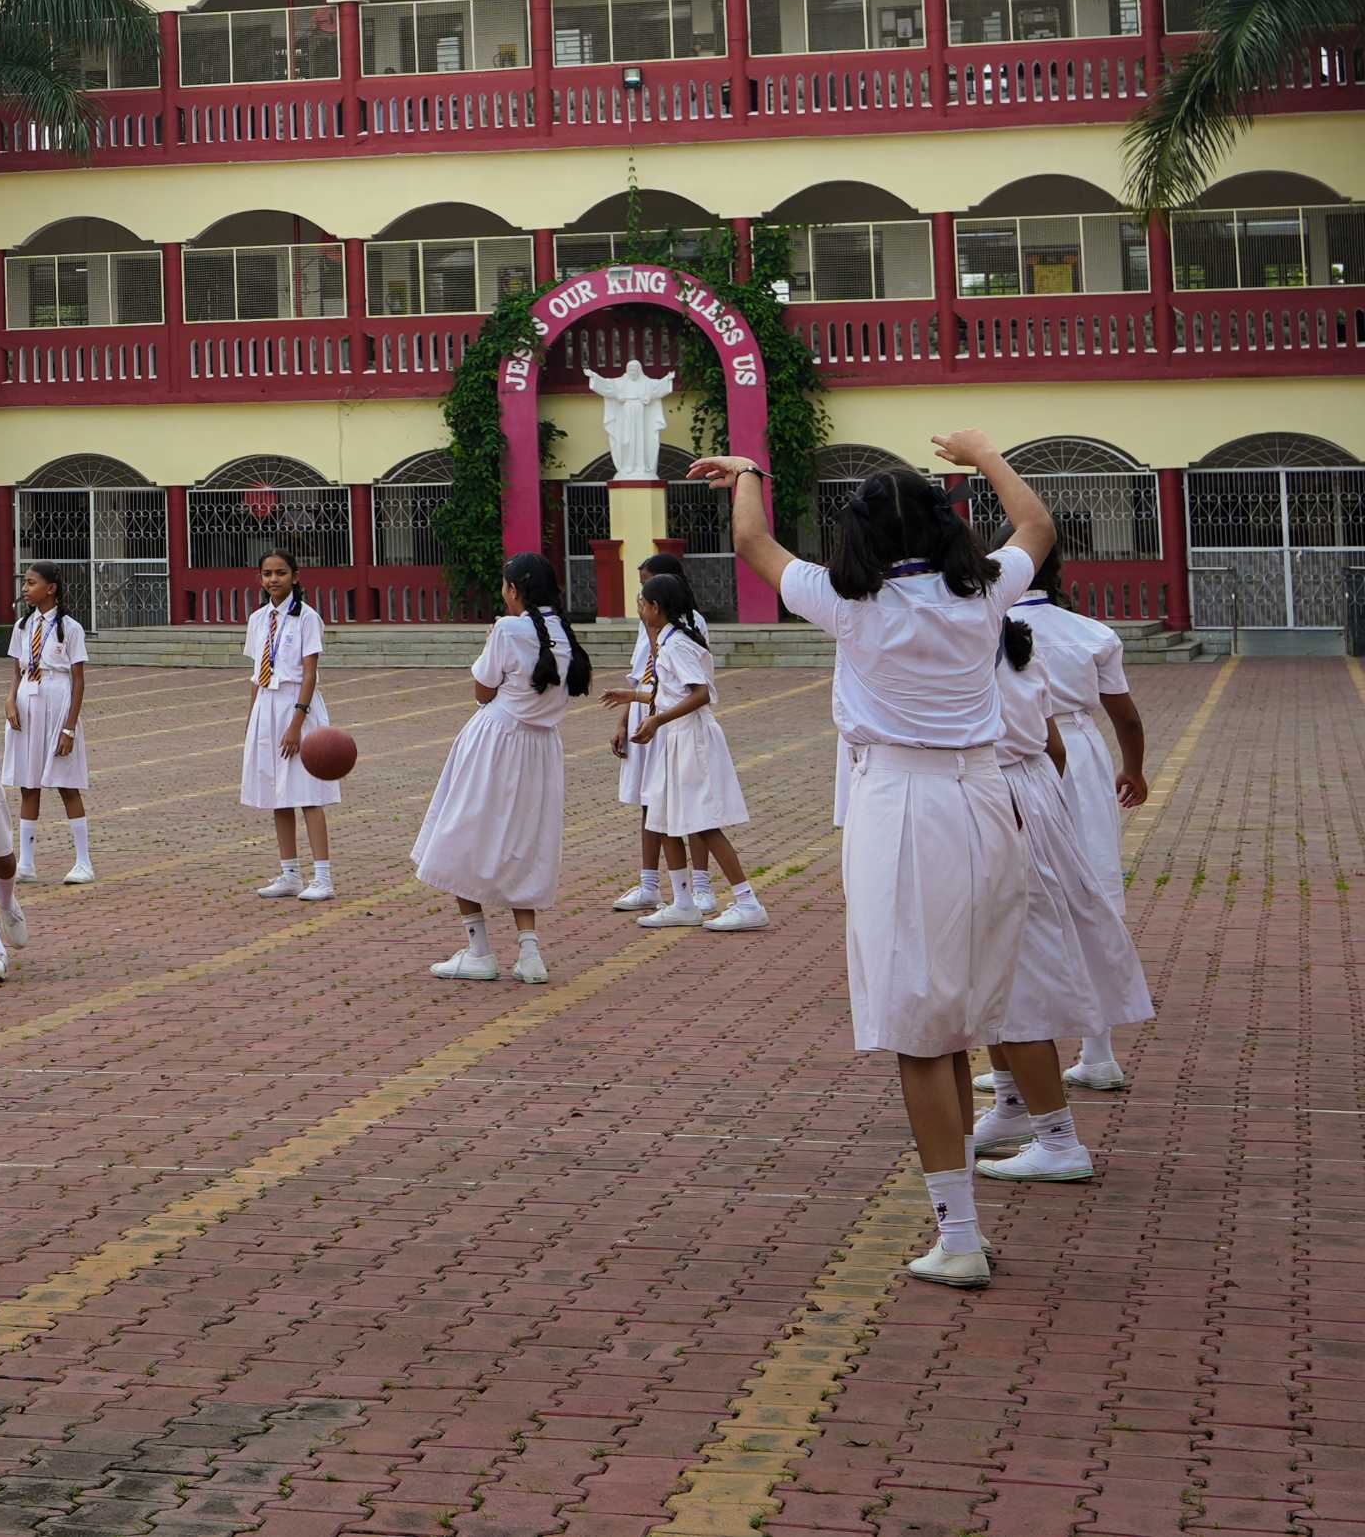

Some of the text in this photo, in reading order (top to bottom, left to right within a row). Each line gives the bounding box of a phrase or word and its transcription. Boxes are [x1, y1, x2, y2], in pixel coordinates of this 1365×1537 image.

[505, 317, 549, 391] JESS
[549, 280, 598, 318] OUR
[733, 353, 757, 386] US
